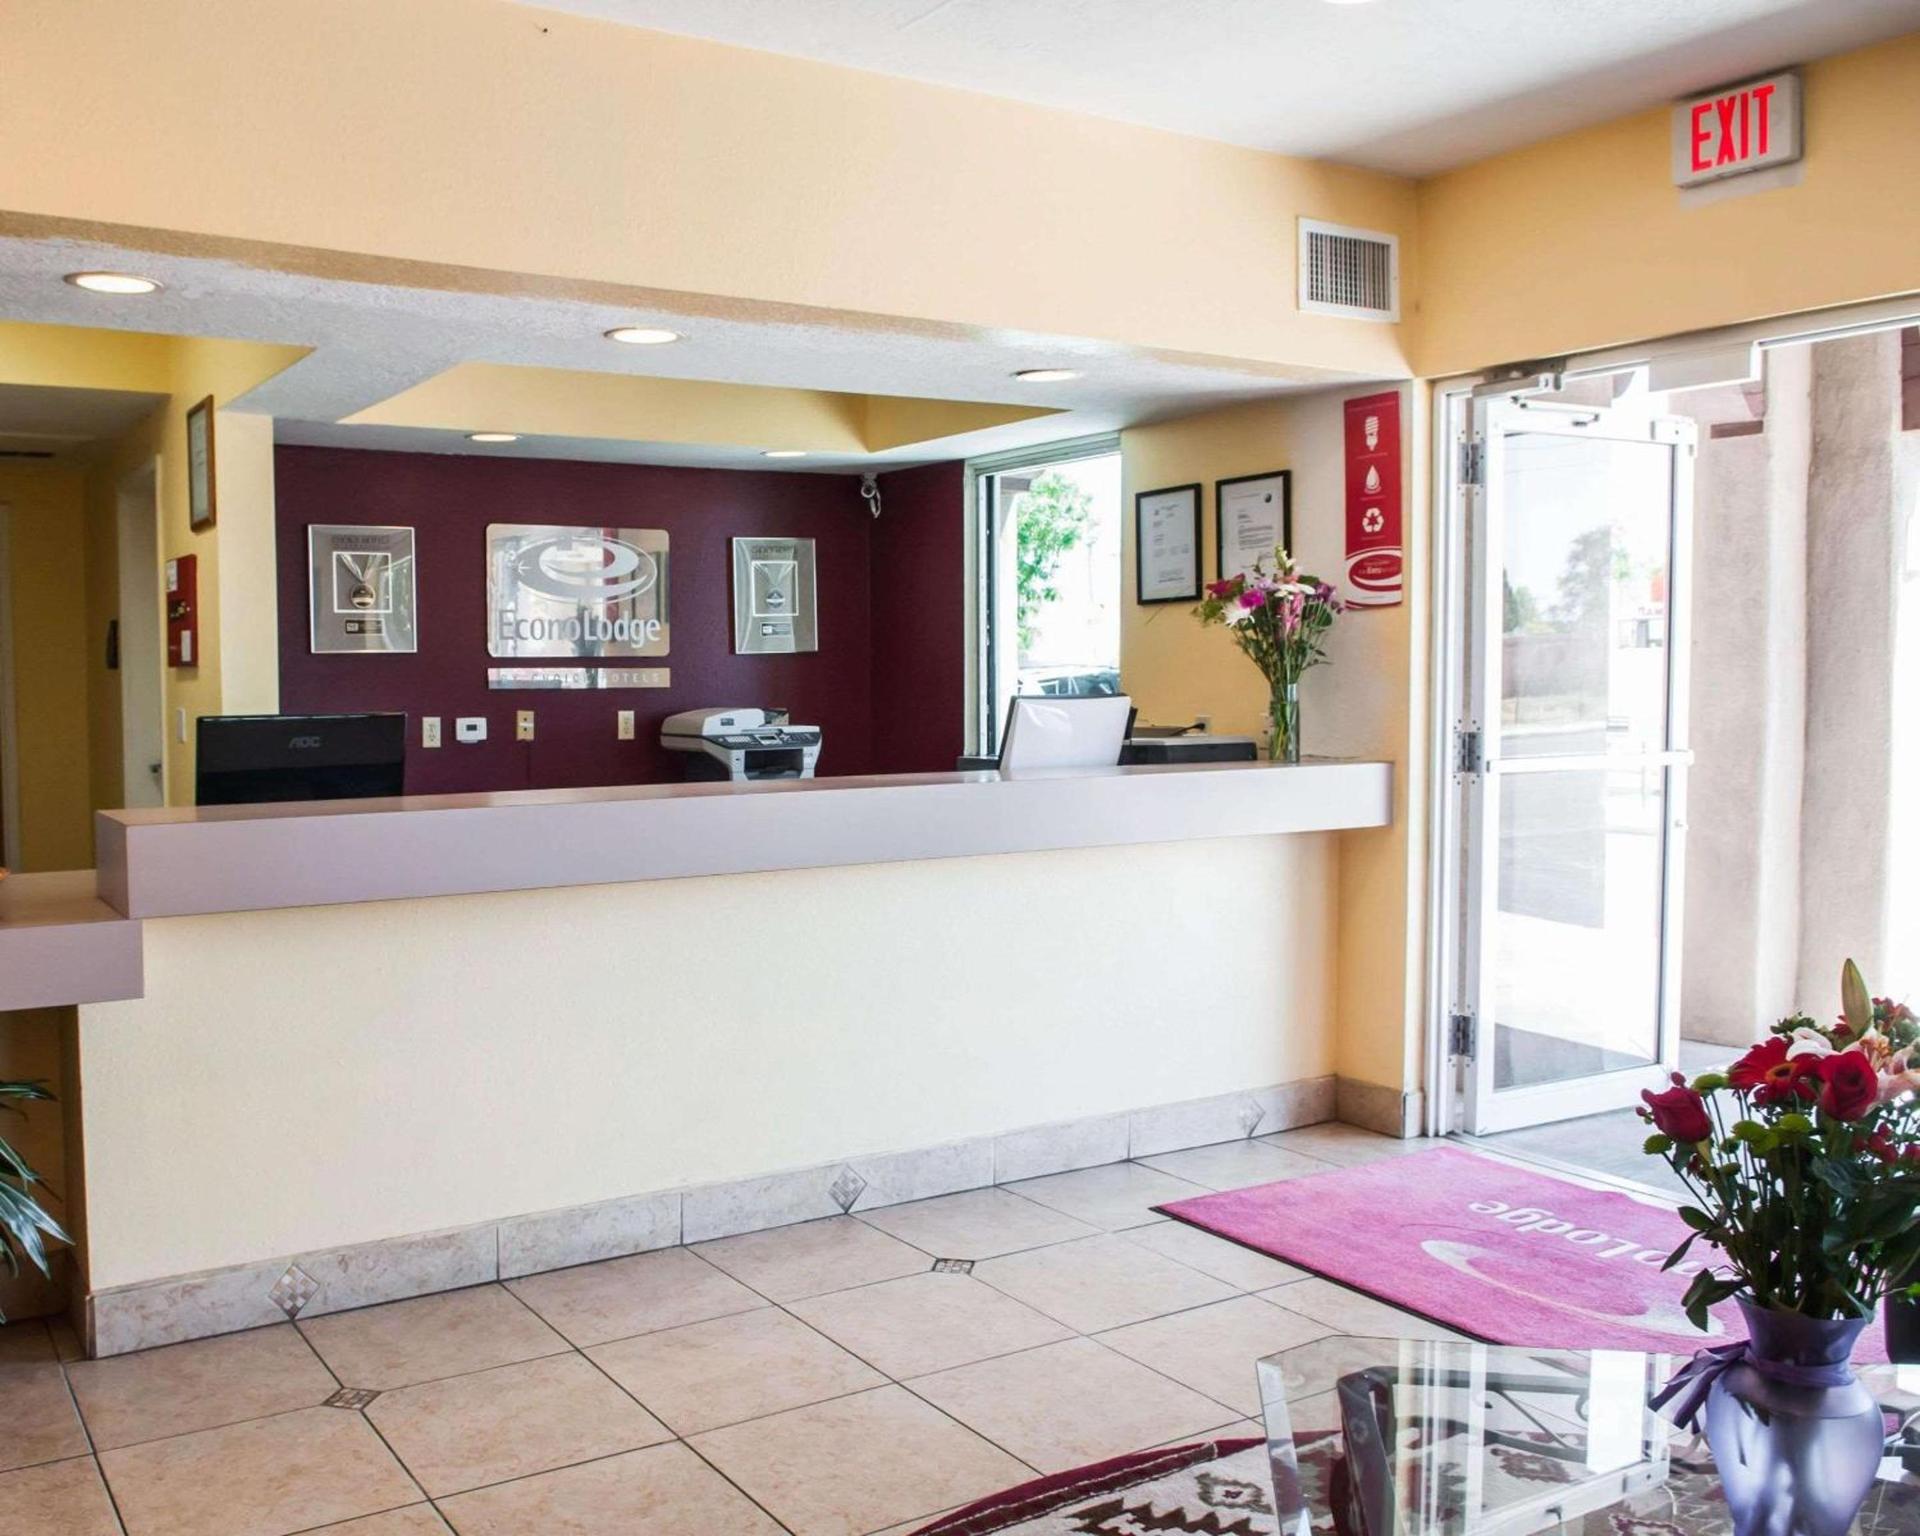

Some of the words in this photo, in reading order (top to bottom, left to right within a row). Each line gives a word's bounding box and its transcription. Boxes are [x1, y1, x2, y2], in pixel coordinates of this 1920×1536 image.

[1690, 83, 1776, 172] EXIT
[498, 609, 661, 648] EconoLodge
[599, 672, 661, 683] OTELS
[288, 736, 321, 748] AOC
